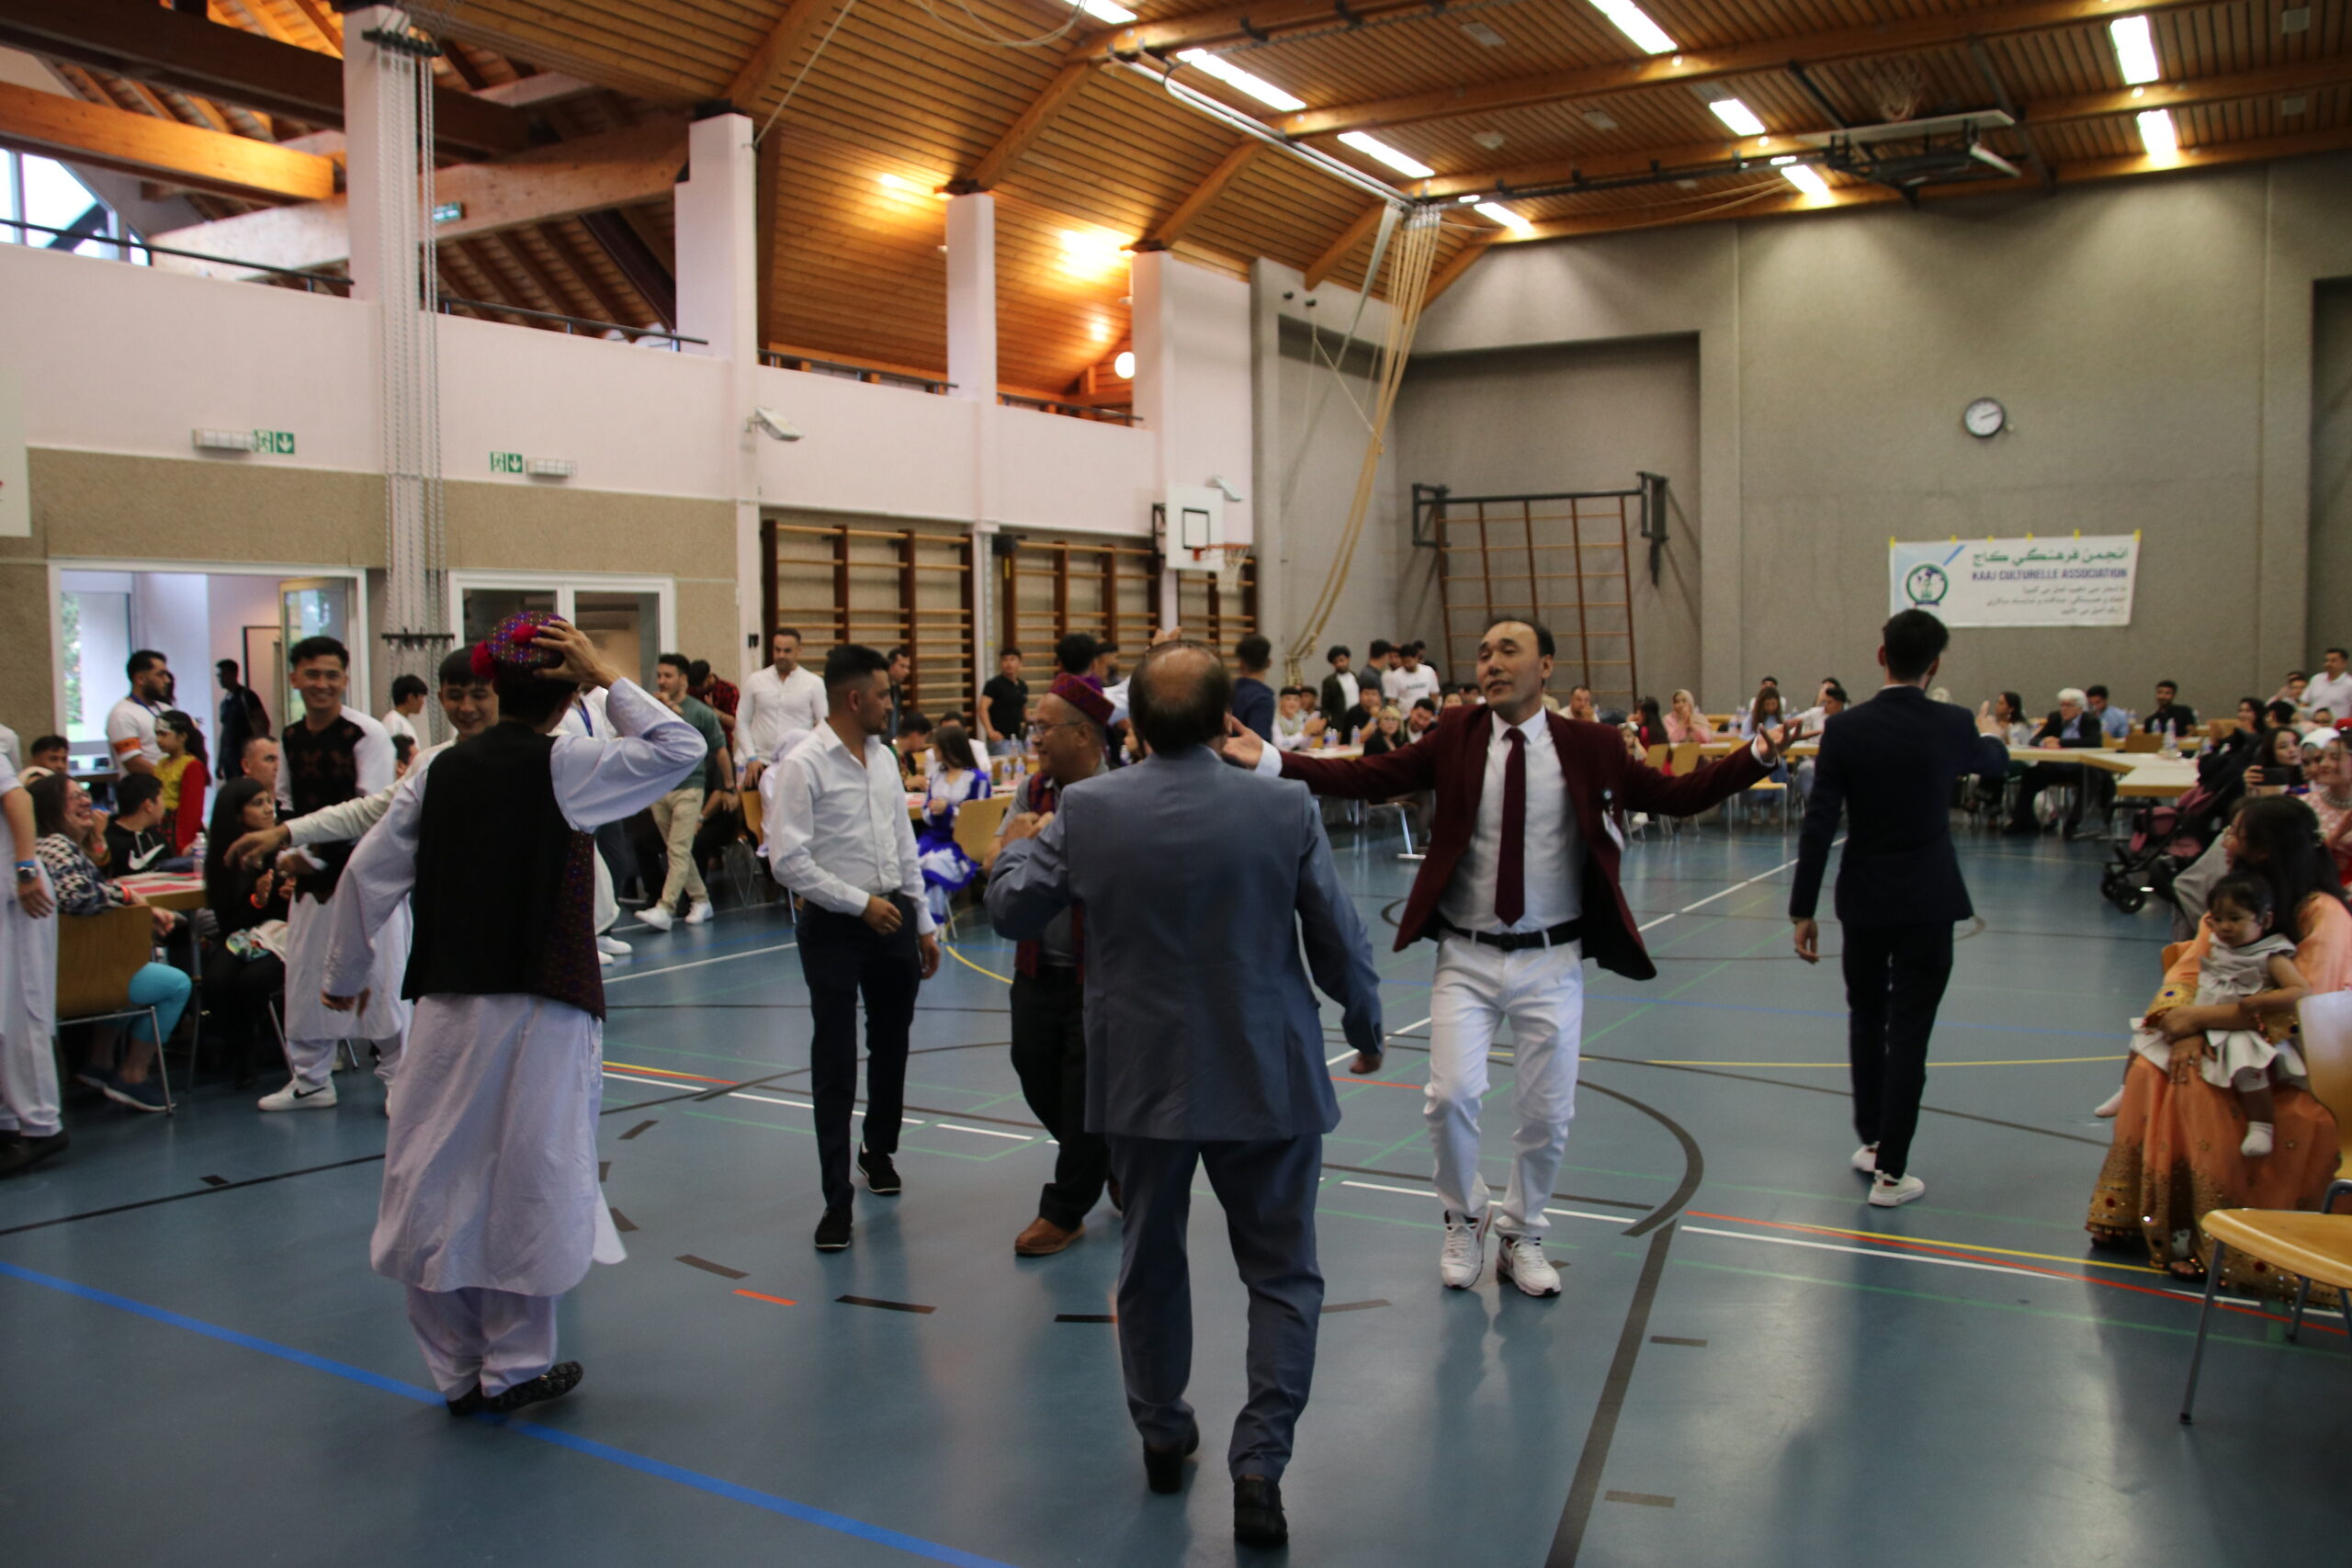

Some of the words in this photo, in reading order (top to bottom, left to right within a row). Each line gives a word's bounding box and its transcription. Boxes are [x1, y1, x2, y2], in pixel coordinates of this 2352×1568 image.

[1973, 570, 1996, 581] KAAJ
[1999, 569, 2058, 580] CULTURELLE
[2061, 568, 2128, 579] ASSOCIATION
